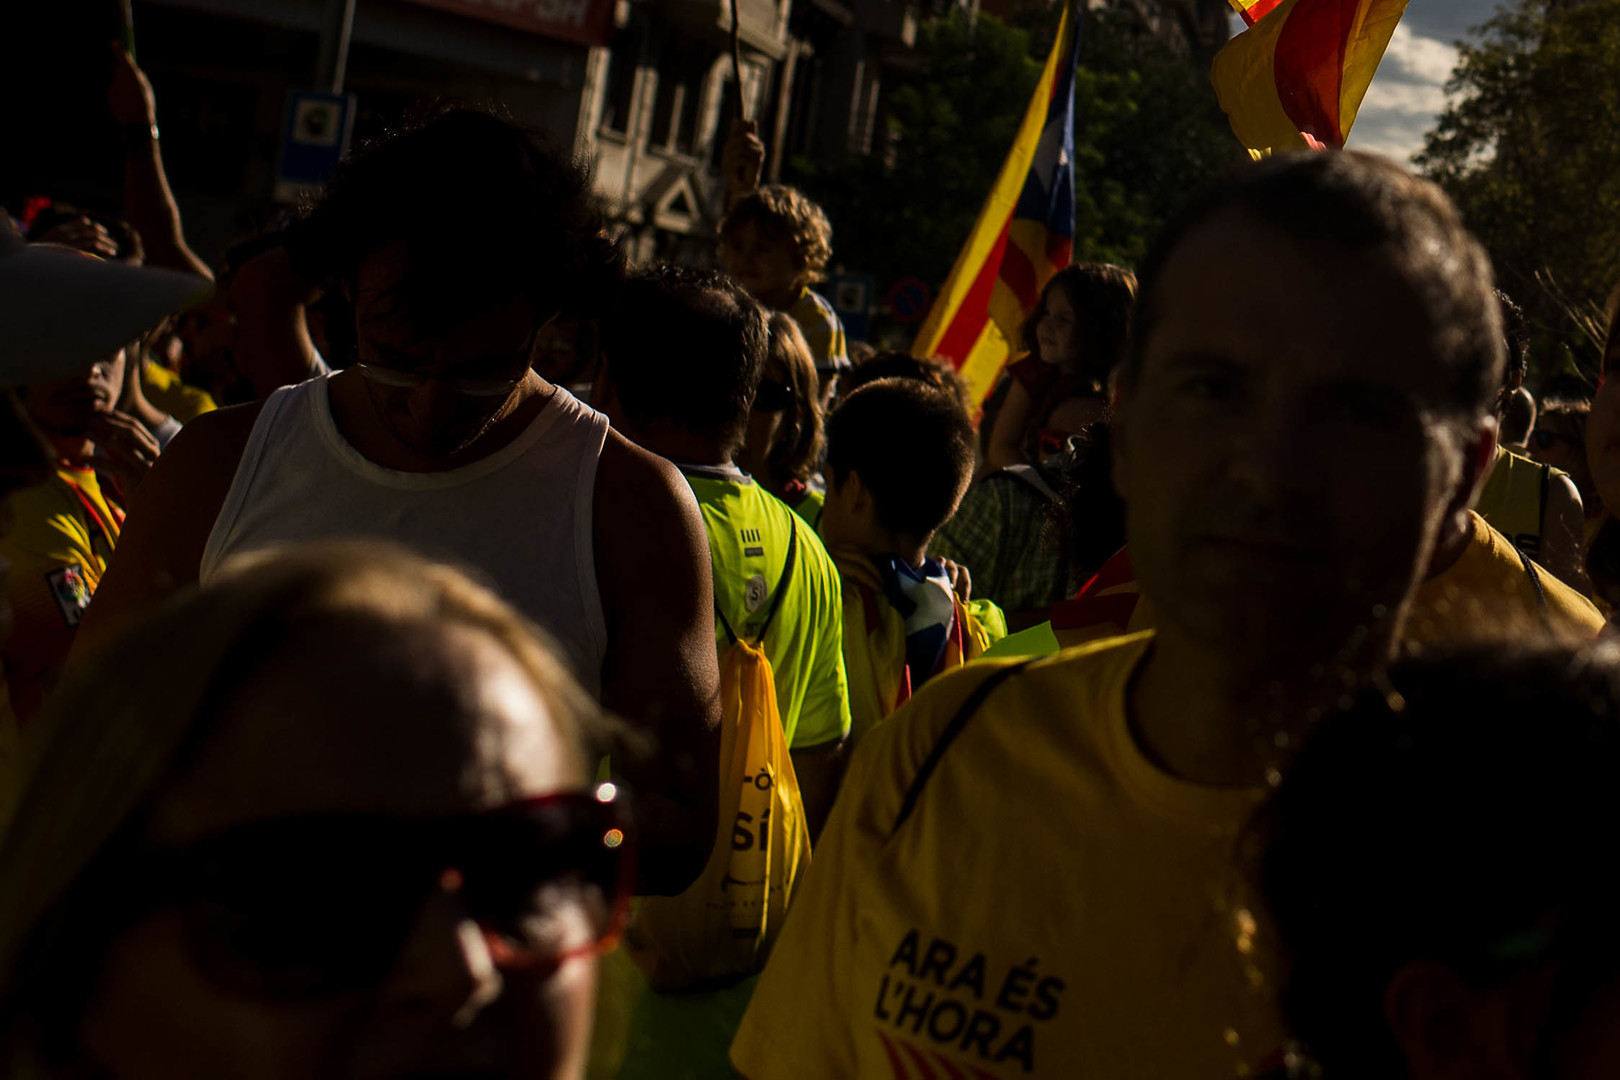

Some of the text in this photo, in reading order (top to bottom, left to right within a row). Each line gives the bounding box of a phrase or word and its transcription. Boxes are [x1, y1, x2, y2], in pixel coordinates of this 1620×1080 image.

[889, 929, 1065, 1020] ARA ÉS
[875, 973, 1033, 1072] L'HORA
